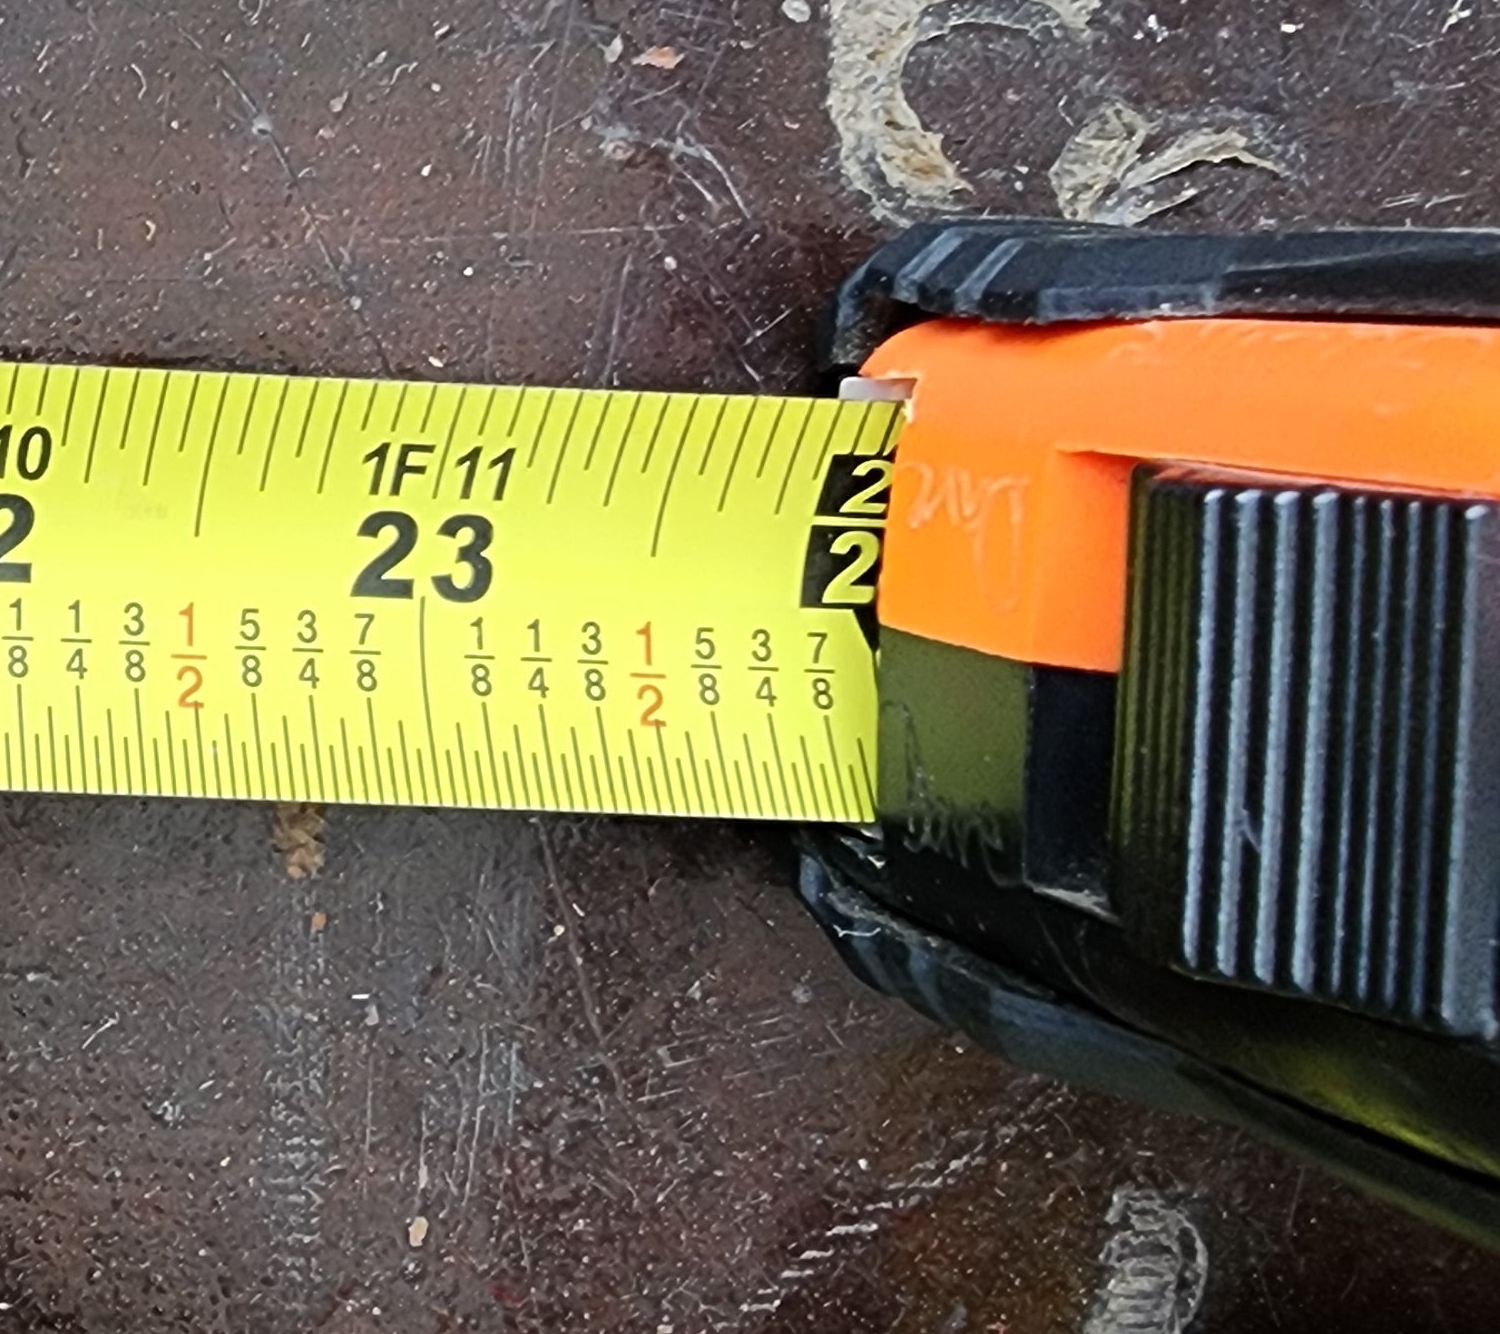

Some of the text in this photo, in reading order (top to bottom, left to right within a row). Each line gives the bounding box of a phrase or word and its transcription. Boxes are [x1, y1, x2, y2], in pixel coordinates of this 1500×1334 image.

[362, 442, 517, 502] 1F 11
[350, 511, 494, 603] 23
